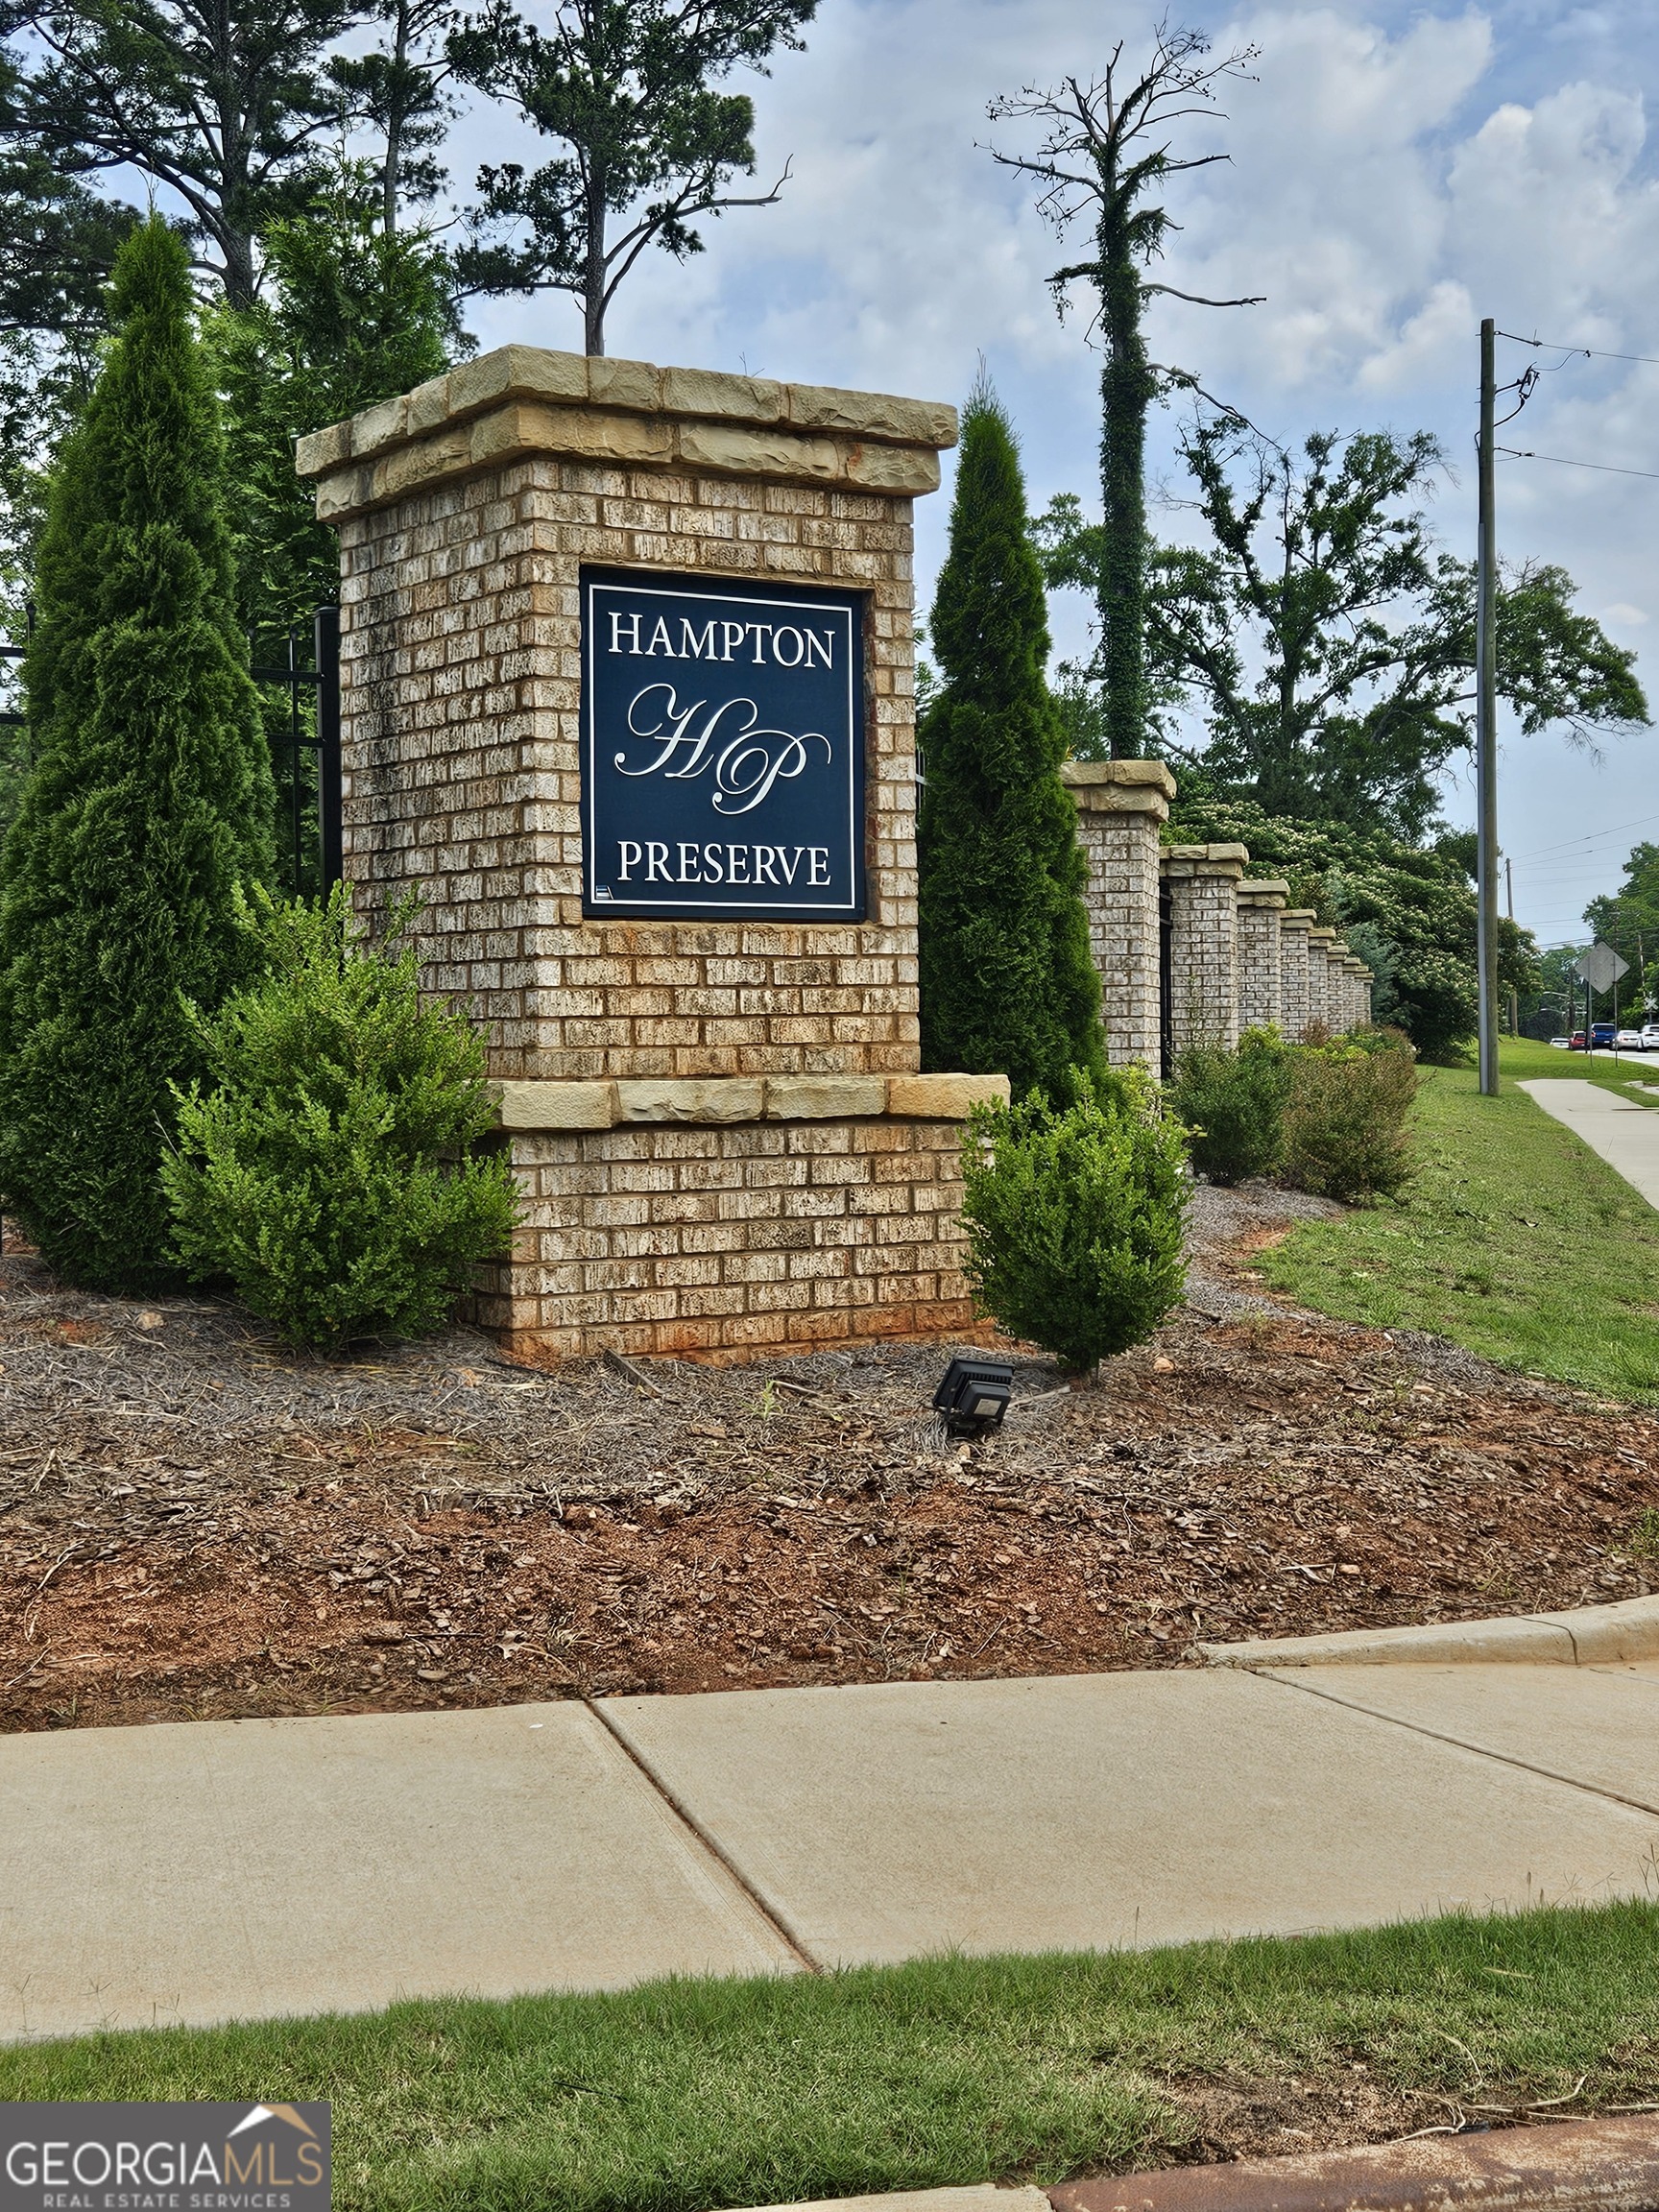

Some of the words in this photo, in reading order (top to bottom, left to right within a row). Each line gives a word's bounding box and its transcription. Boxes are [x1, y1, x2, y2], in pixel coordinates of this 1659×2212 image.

[608, 612, 835, 670] HAMPTON
[614, 683, 831, 815] HP
[616, 840, 831, 886] PRESERVE
